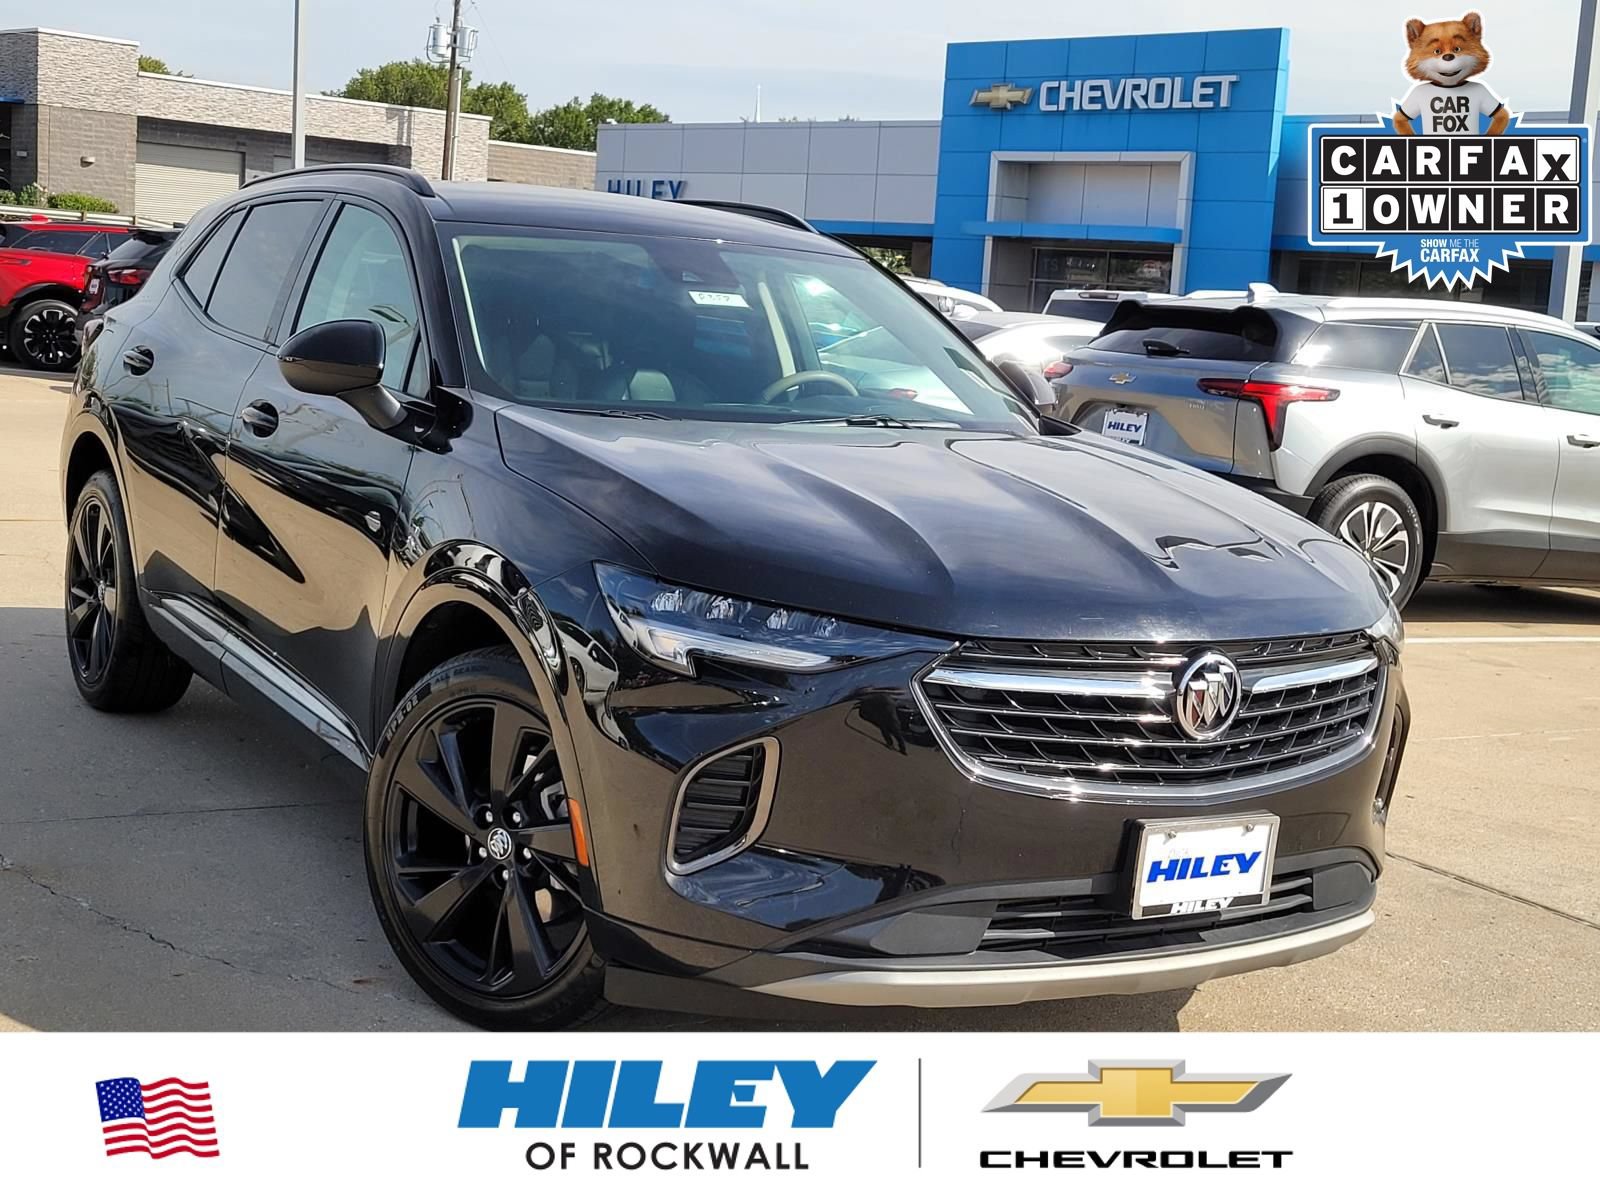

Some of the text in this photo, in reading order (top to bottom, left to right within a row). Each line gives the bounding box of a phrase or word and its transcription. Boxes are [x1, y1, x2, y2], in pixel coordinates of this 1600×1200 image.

[1039, 75, 1239, 111] CHEVROLET
[1107, 421, 1142, 433] HILEY
[1146, 851, 1262, 883] HILEY
[1170, 897, 1234, 915] HILEY
